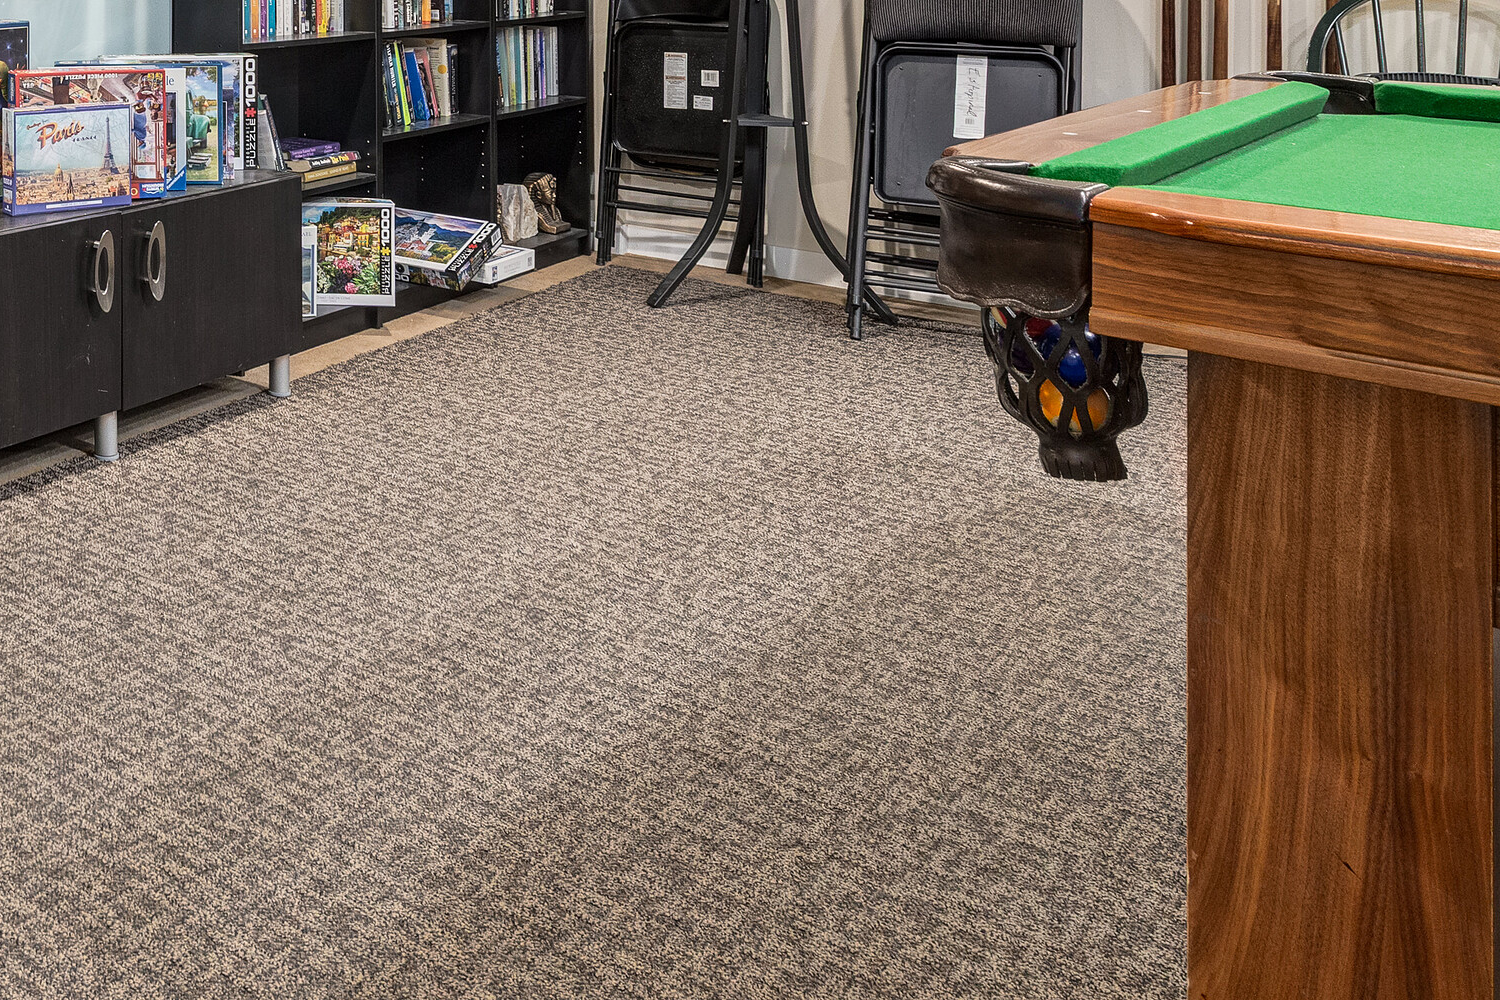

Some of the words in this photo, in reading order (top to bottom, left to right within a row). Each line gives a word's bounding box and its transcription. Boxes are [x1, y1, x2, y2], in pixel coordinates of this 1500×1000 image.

[245, 58, 256, 107] 1000
[36, 118, 84, 150] Paris
[381, 208, 390, 246] 1000
